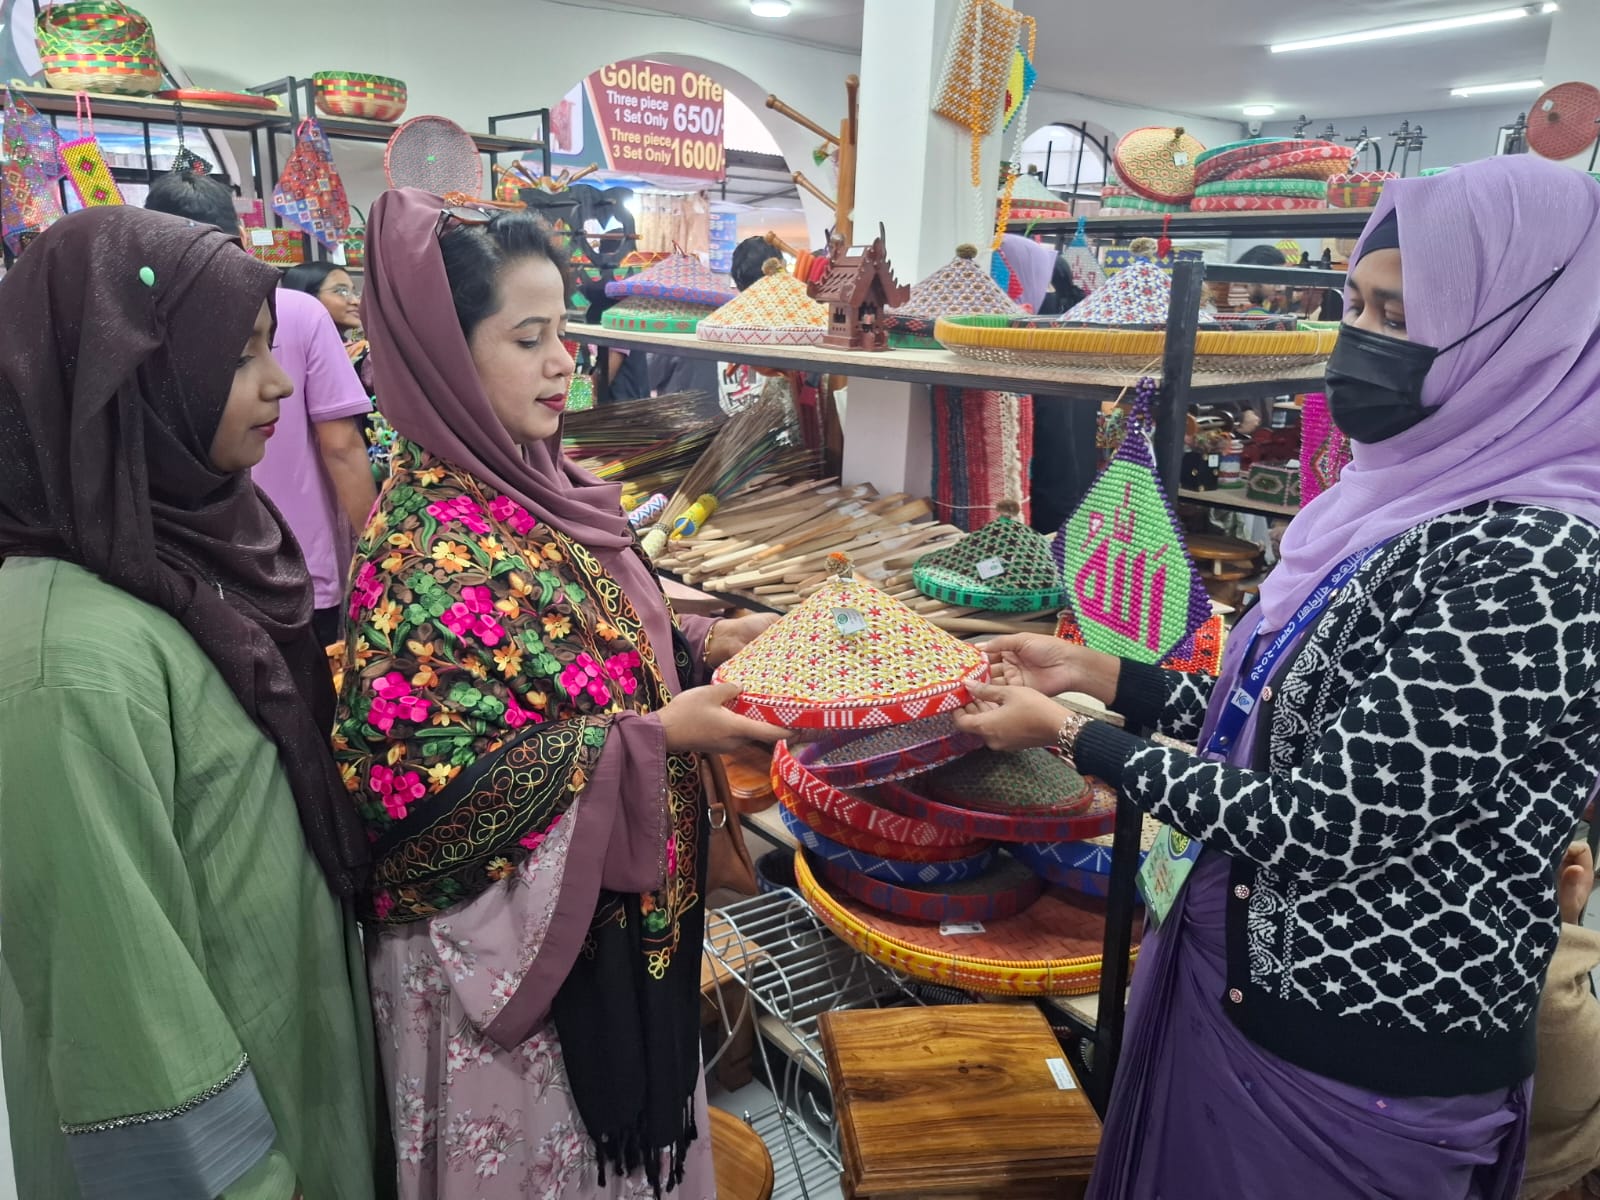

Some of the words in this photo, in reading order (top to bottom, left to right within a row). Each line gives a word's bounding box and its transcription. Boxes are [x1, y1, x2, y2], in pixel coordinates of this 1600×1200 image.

[600, 63, 675, 95] Golden
[681, 73, 724, 102] Offe
[606, 90, 638, 106] Three
[640, 95, 669, 112] piece
[614, 109, 621, 122] 1
[623, 111, 643, 125] Set
[644, 112, 669, 131] Only
[610, 127, 641, 144] Three
[643, 132, 672, 148] piece
[613, 145, 621, 158] 3
[623, 147, 643, 161] Set
[644, 149, 672, 166] Only
